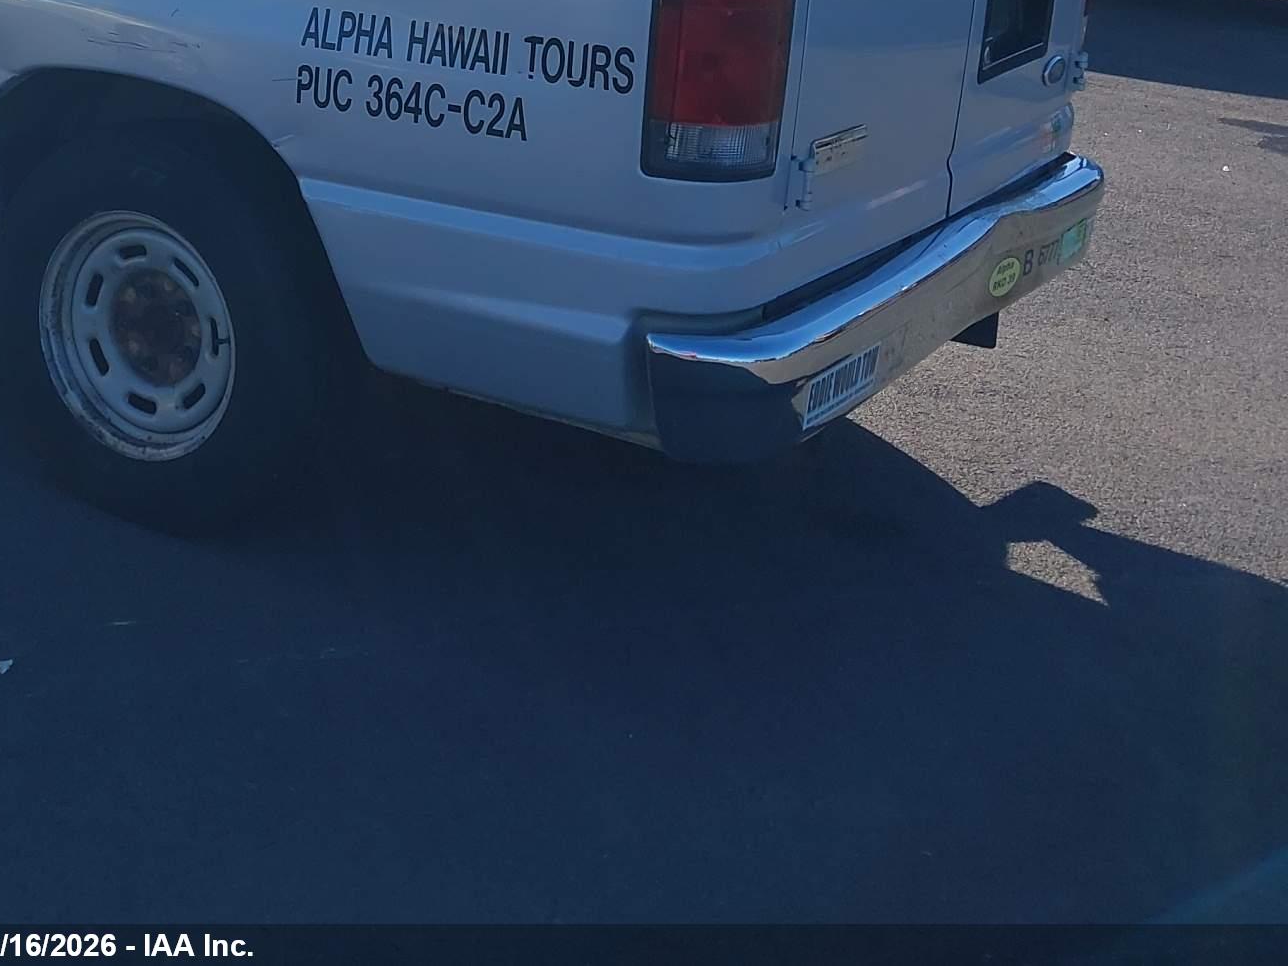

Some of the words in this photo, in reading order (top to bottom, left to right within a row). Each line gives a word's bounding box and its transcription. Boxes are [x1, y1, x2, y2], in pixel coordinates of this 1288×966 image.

[301, 7, 393, 59] ALPHA
[406, 20, 510, 76] HAWAII
[524, 36, 635, 94] TOURS
[296, 65, 353, 112] PUC
[365, 75, 528, 142] 364C-C2A
[1023, 249, 1034, 276] B
